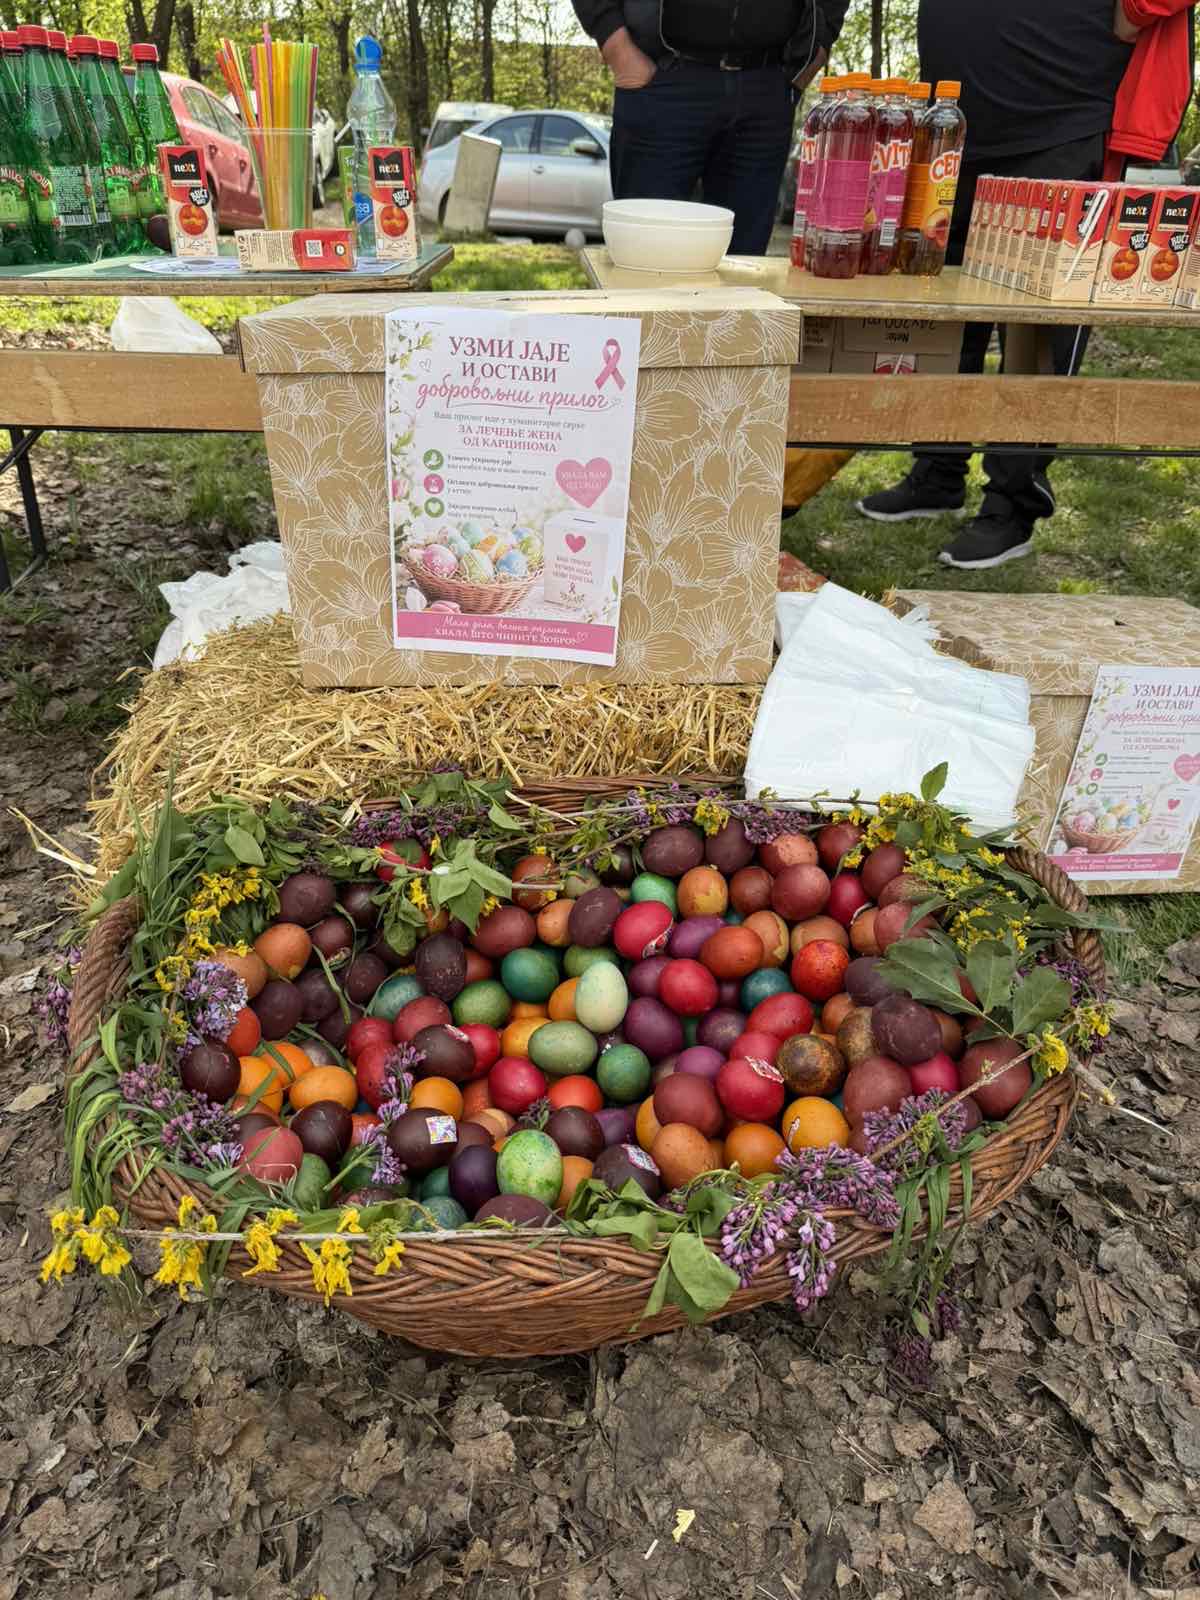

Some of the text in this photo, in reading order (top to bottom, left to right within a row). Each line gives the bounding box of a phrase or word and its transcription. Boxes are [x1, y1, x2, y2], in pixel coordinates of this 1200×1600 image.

[448, 336, 571, 363] УЗМИ ЈАЈЕ
[462, 362, 557, 383] И ОСТАВИ
[416, 374, 610, 415] добровољни прилог
[454, 413, 484, 424] прилог
[457, 425, 562, 441] ЗА ЛЕЧЕЊЕ ЖЕНА
[463, 437, 557, 452] ОД КАРЦИНОМА
[434, 627, 470, 640] ХВАЛА
[471, 629, 494, 641] ШТО
[495, 631, 538, 643] ЧИНИТЕ
[1132, 683, 1172, 697] УЗМИ
[1136, 699, 1194, 710] И ОСТАВИ
